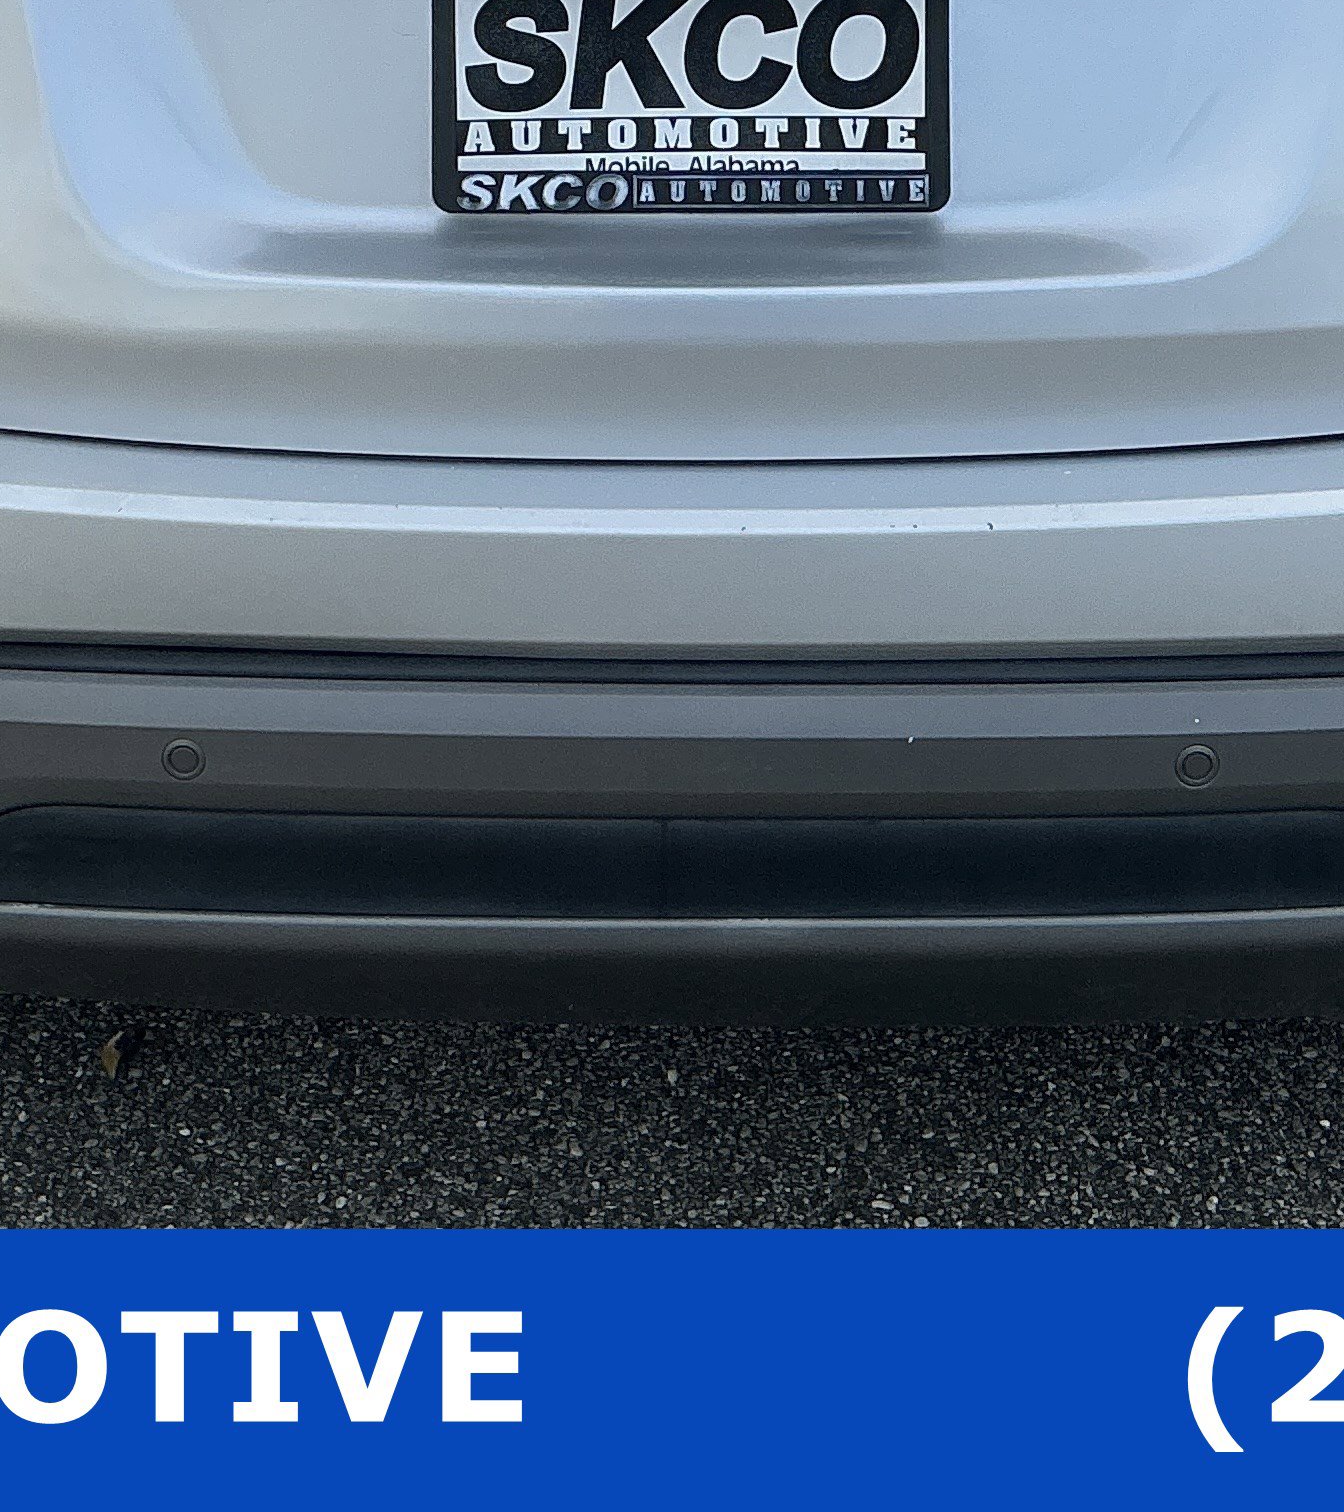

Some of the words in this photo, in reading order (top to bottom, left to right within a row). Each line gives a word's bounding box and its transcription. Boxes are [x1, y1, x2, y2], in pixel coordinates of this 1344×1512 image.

[464, 117, 918, 153] AUTOMOTIVE
[457, 173, 630, 211] SKCO
[639, 177, 924, 203] AUTOMOTIVE
